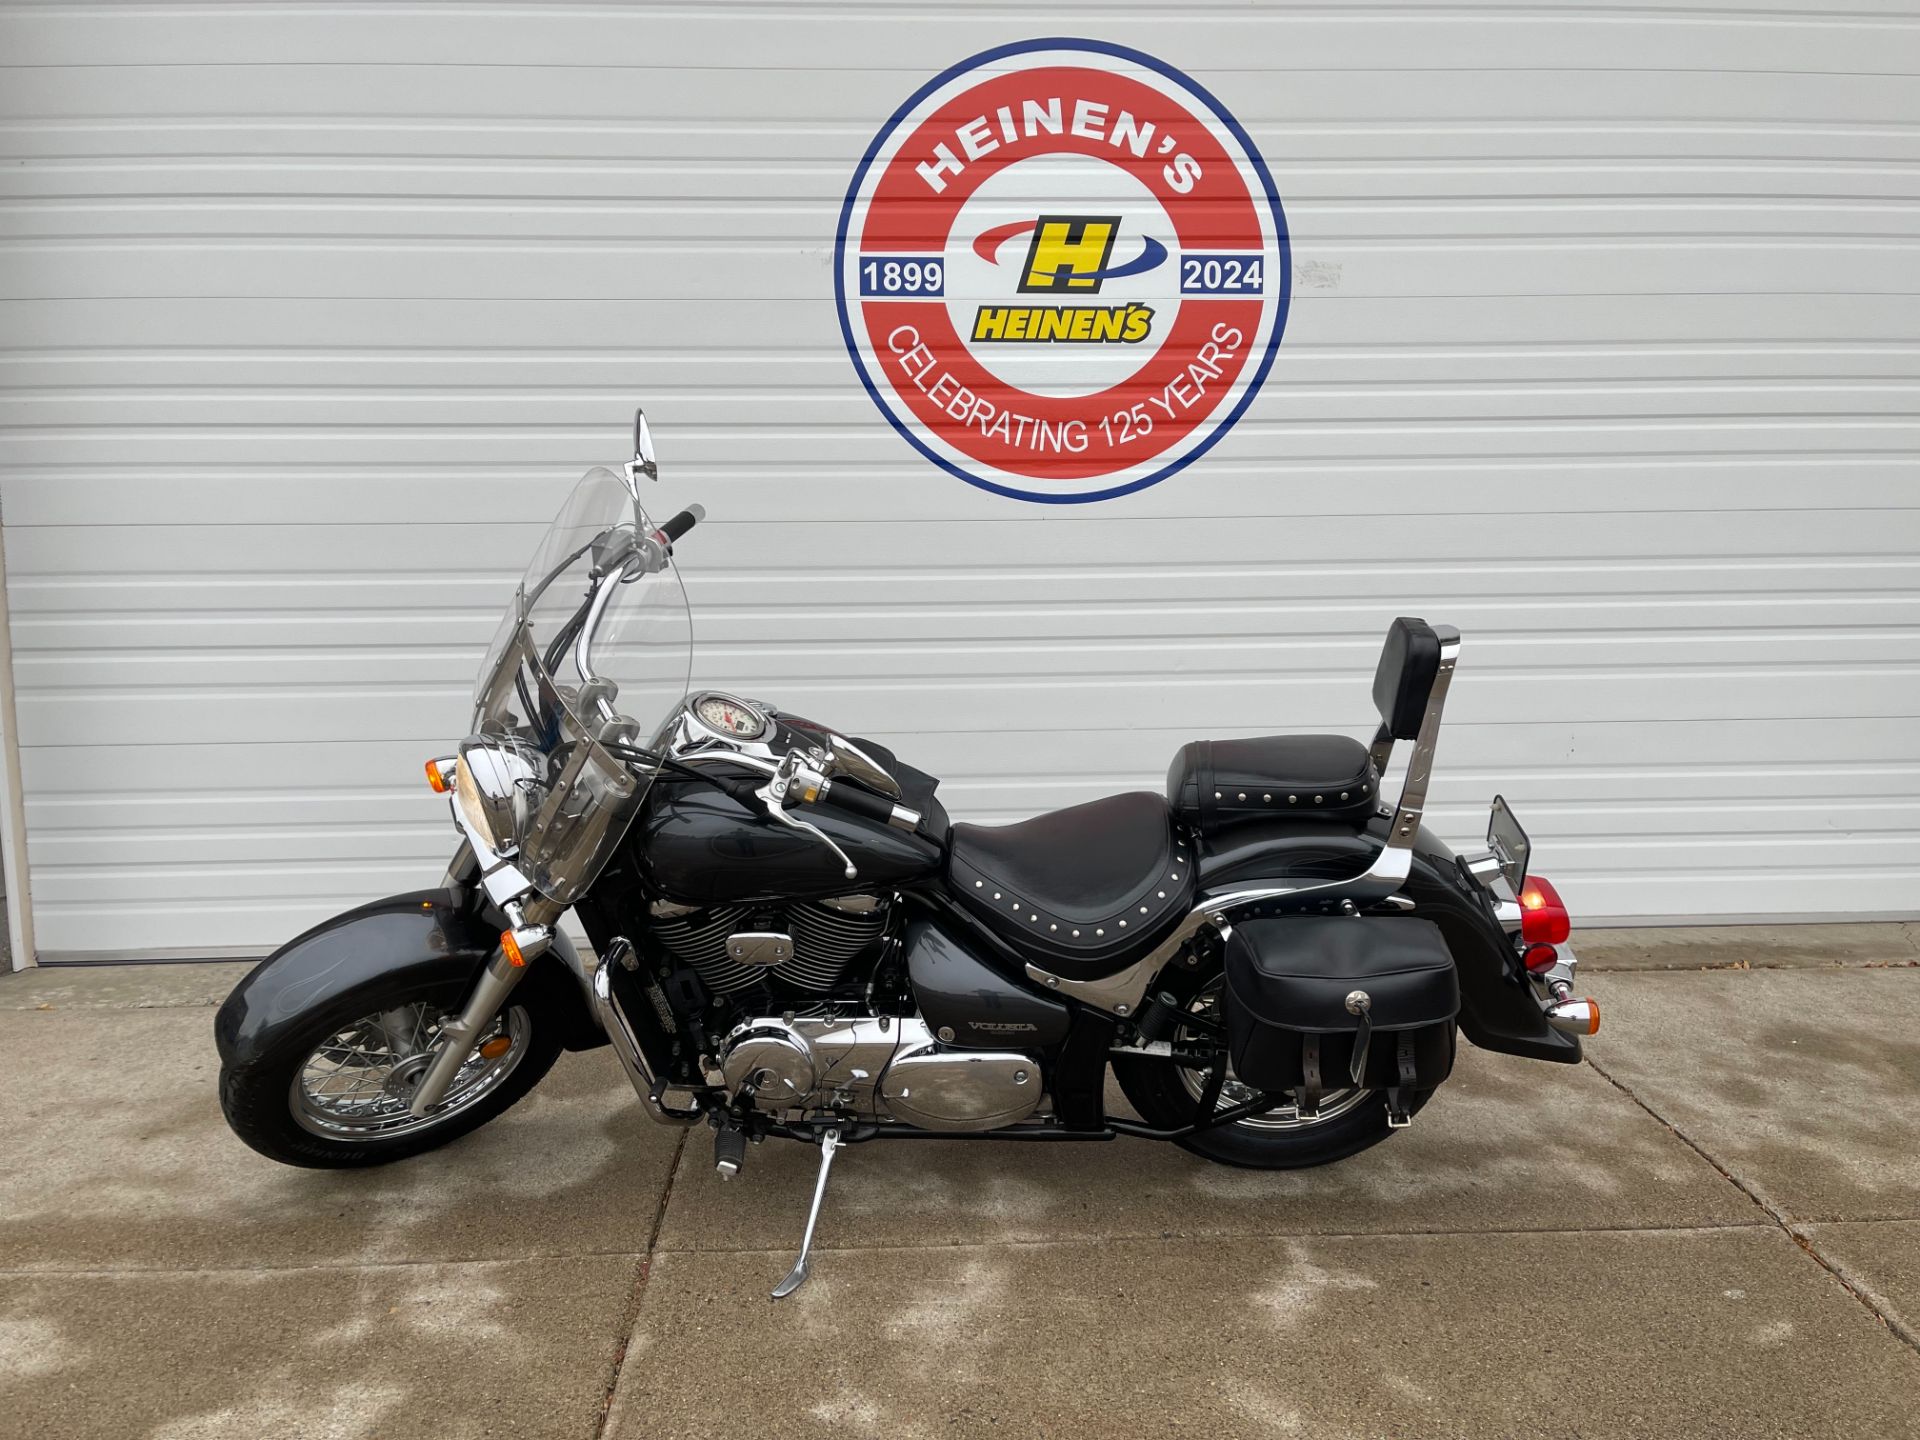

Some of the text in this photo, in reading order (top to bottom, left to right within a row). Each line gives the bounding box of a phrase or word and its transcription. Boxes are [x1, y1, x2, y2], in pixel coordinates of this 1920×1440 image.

[915, 98, 1203, 194] HEINEN'S
[864, 262, 943, 291] 1899
[1024, 222, 1113, 287] H
[1183, 260, 1262, 289] 2024
[971, 303, 1155, 342] HEINEN'S
[888, 322, 1243, 453] CELEBRATING 125 YEARS
